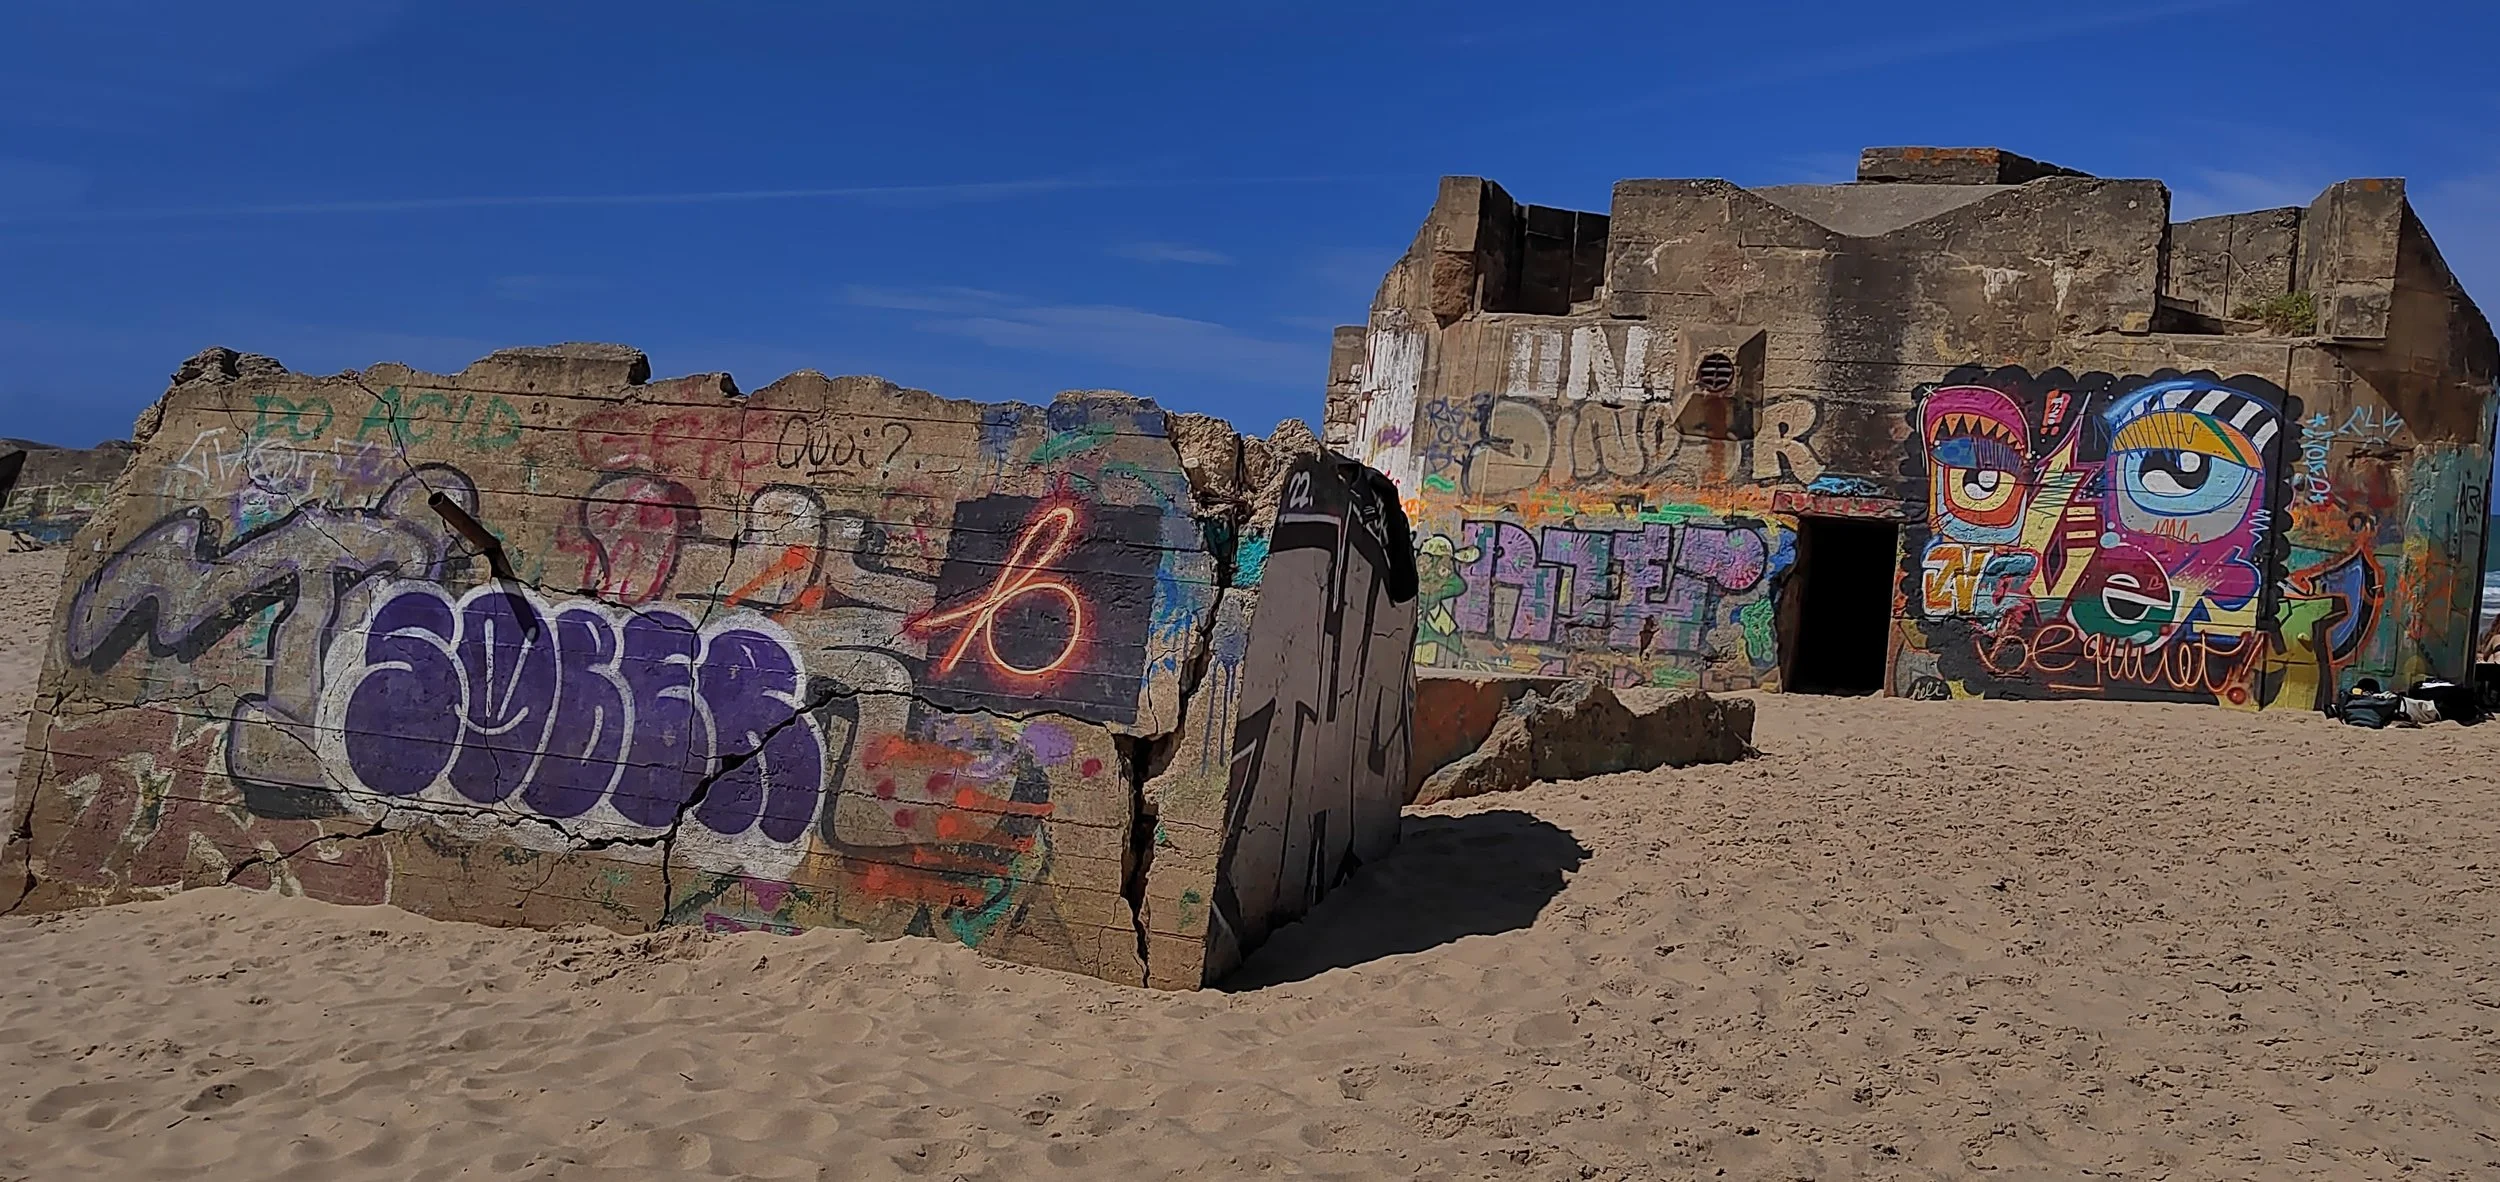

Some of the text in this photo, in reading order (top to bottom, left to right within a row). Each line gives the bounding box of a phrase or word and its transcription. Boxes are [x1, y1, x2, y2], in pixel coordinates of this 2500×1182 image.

[252, 384, 523, 450] DO ACID
[335, 578, 830, 850] SOBER
